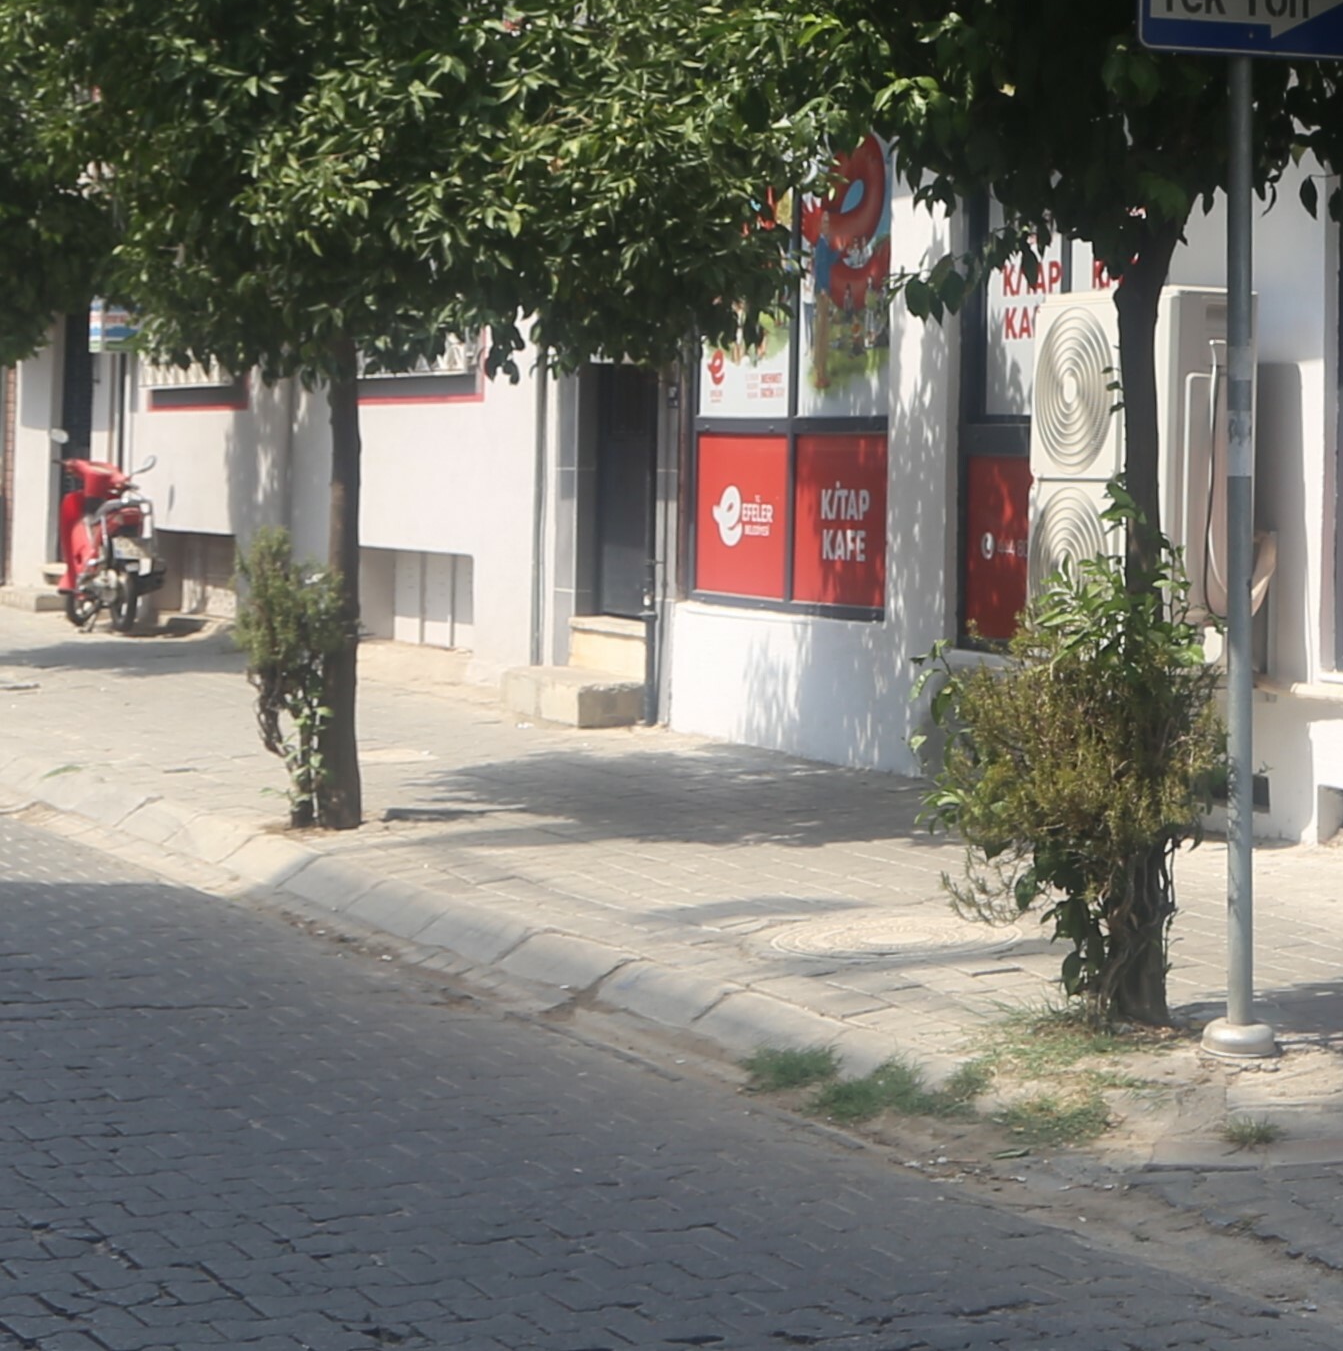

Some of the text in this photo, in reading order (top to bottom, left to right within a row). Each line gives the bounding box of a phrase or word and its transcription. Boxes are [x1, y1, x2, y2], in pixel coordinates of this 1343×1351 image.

[741, 502, 774, 524] EFELER
[820, 480, 871, 521] KİTAP
[822, 528, 867, 562] KAFE
